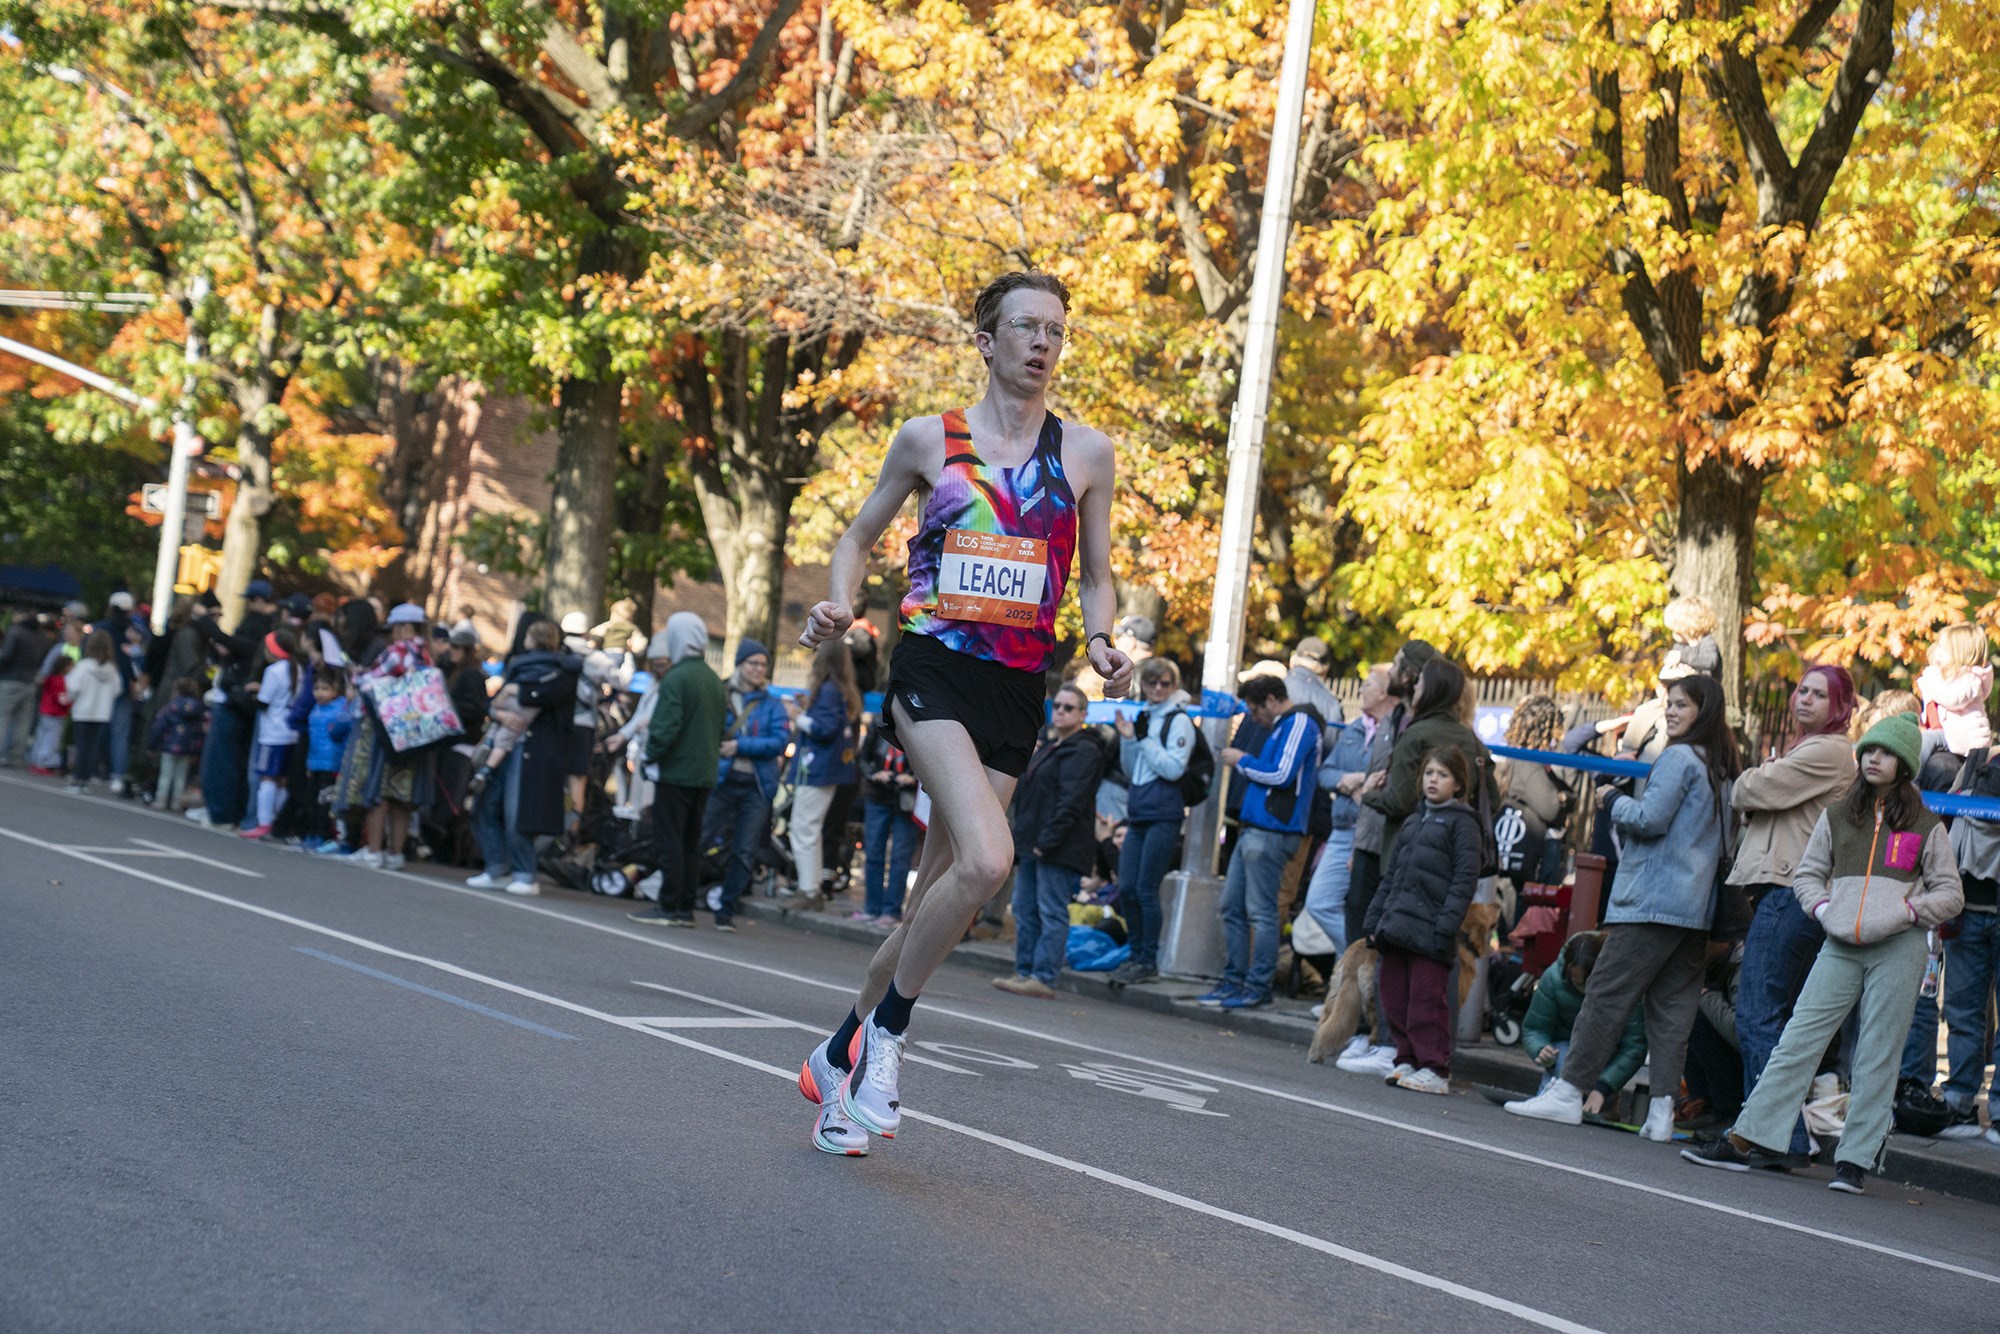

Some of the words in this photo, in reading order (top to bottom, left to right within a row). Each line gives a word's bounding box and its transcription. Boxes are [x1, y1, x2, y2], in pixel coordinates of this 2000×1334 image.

[957, 533, 978, 548] tcs
[959, 562, 1026, 598] LEACH
[1005, 608, 1033, 621] 2025
